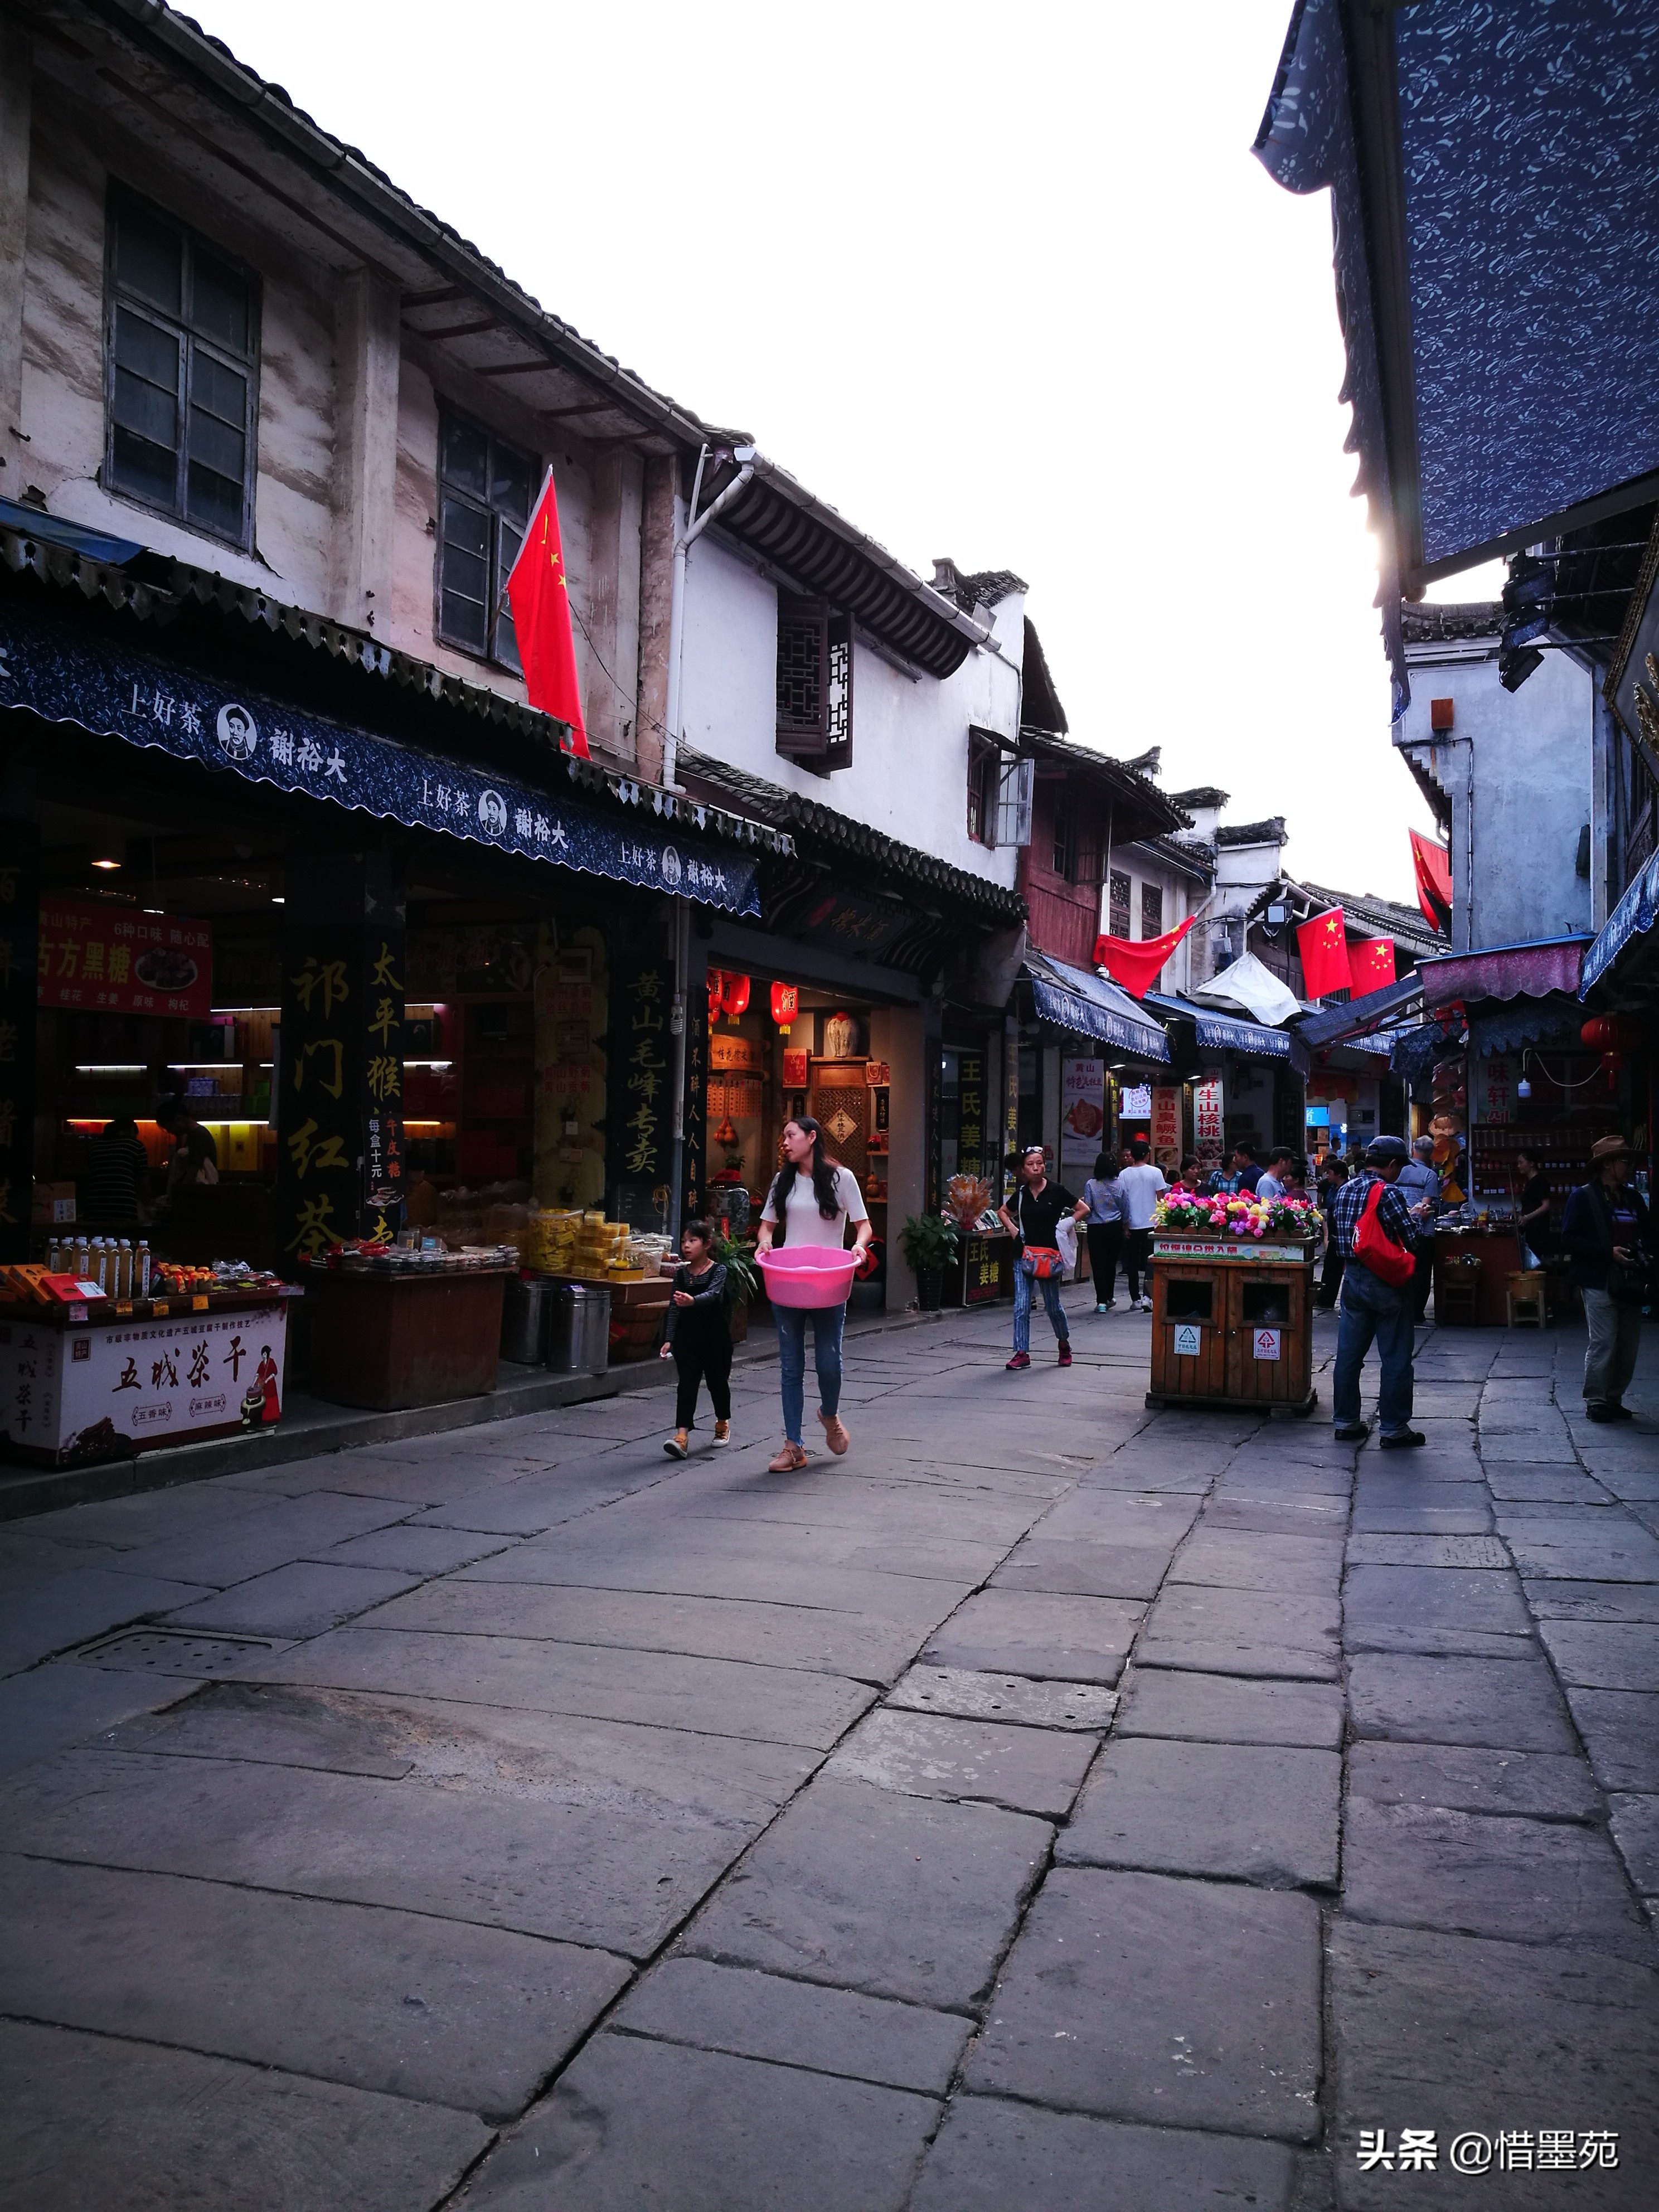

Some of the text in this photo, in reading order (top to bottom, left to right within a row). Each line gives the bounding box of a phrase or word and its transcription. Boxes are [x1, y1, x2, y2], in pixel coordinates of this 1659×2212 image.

[121, 685, 202, 736] 上好茶
[270, 728, 348, 783] 謝裕大
[418, 779, 470, 817] 上好茶
[515, 808, 569, 850] 謝裕大
[618, 842, 657, 872] 上好茶
[687, 858, 727, 893] 謝裕大
[114, 923, 162, 942] 6种口味
[170, 929, 210, 948] 随心配
[38, 934, 130, 984] 古方黑糖
[60, 988, 83, 1002] 桂花
[97, 992, 119, 1005] 生姜
[133, 995, 154, 1008] 原味
[168, 998, 189, 1011] 枸杞
[782, 990, 796, 1012] 酒
[625, 969, 666, 1174] 黄山毛峰专卖
[1075, 1063, 1095, 1073] 黄山
[283, 957, 350, 1255] 祁门红茶
[960, 1060, 981, 1182] 王氏姜糖
[1197, 1076, 1220, 1138] 野生山核桃
[368, 1119, 382, 1178] 每盒十元
[386, 1118, 401, 1179] 牛皮糖
[968, 1239, 989, 1263] 王氏
[979, 1260, 1000, 1286] 姜糖
[112, 1336, 247, 1393] 五城茶干
[139, 1408, 167, 1420] 五香味
[195, 1399, 222, 1411] 麻辣味
